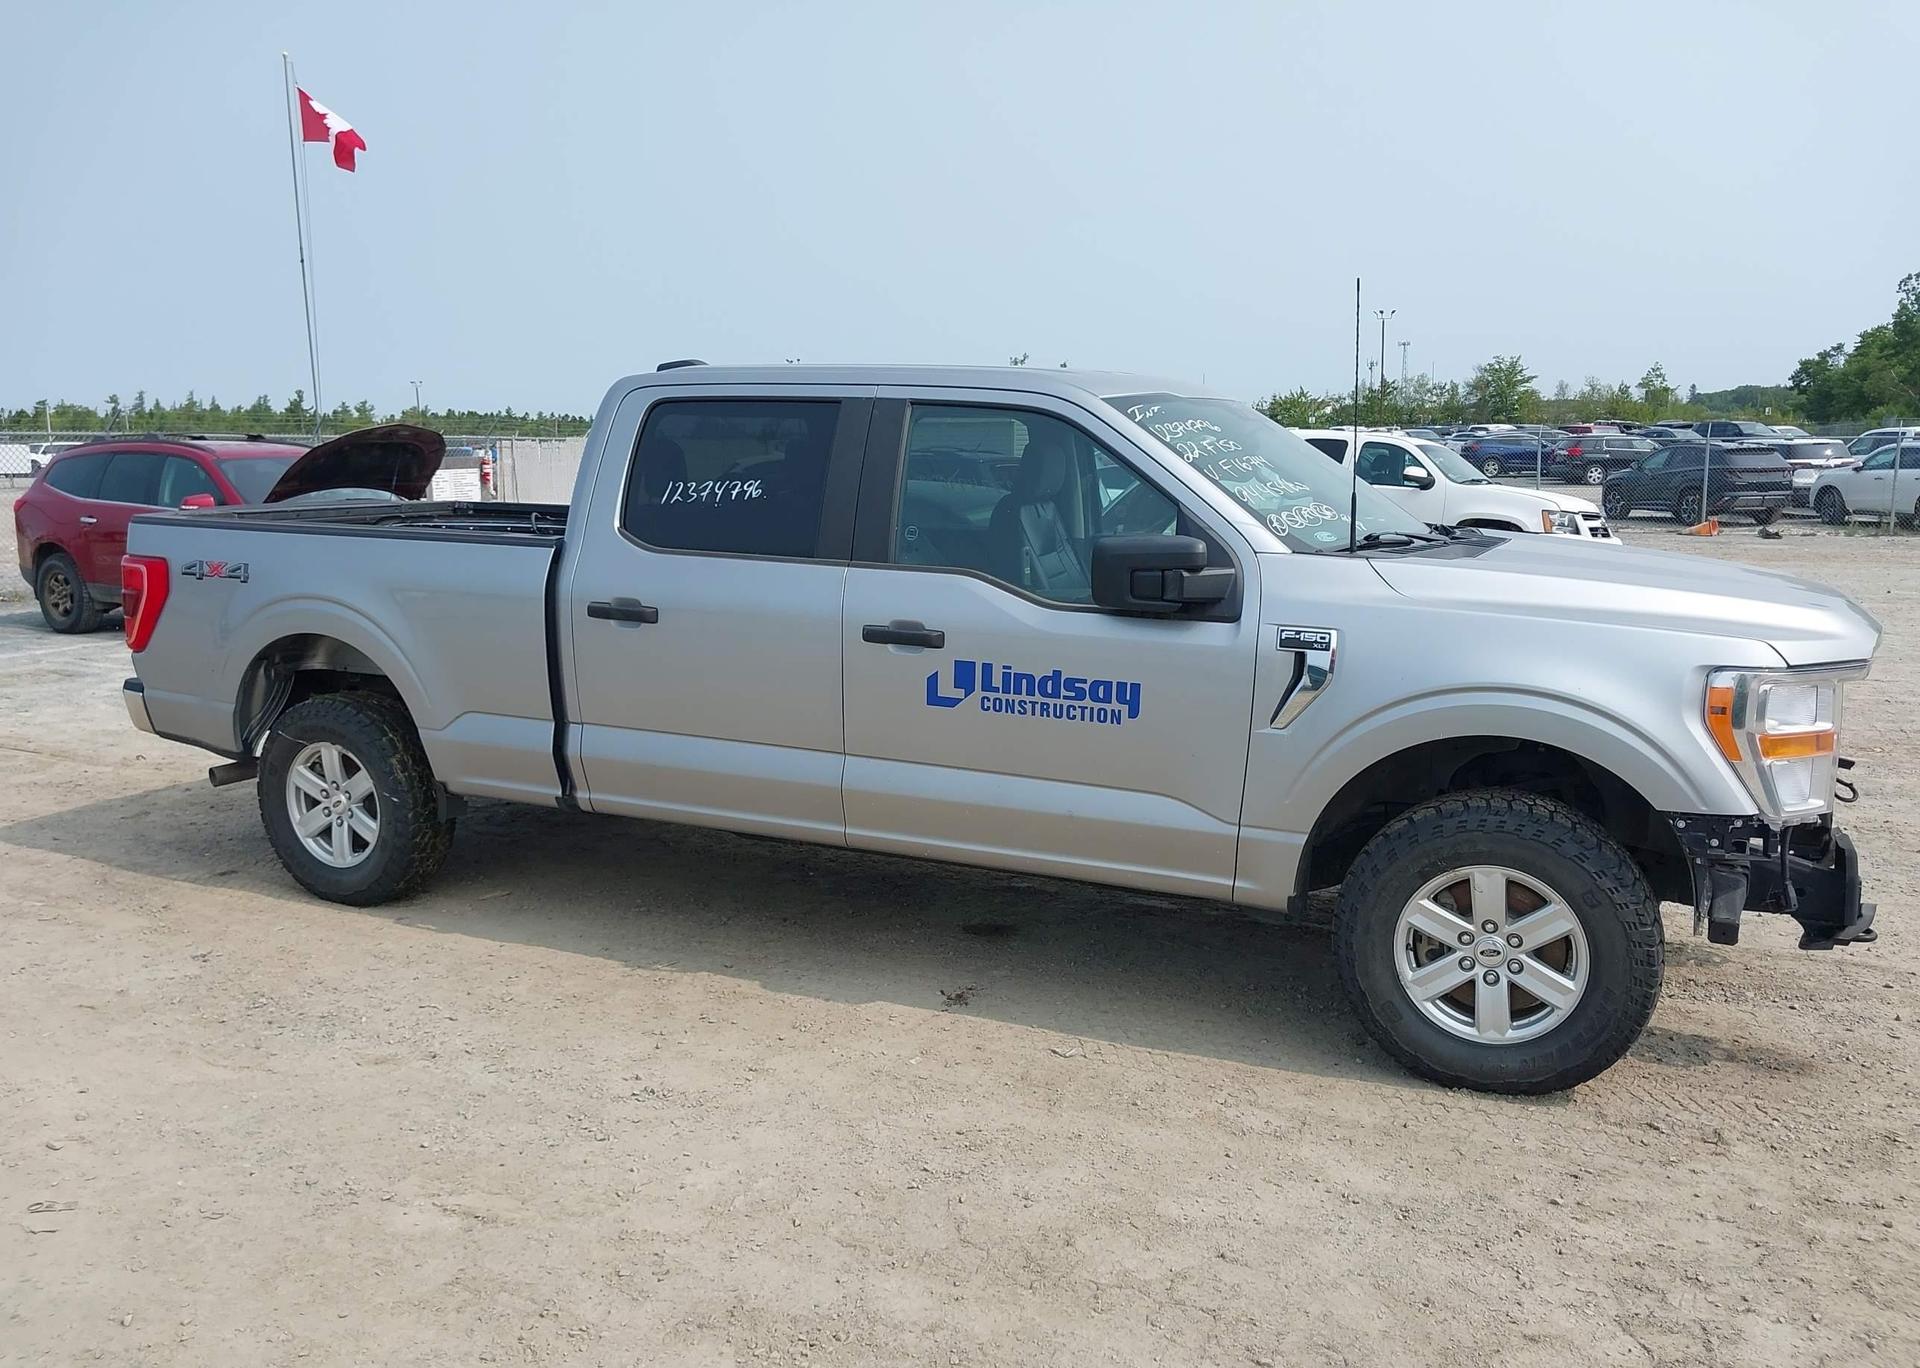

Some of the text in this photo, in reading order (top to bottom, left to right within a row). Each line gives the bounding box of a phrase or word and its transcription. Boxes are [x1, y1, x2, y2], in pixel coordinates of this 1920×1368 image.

[1281, 631, 1330, 643] F-150
[981, 662, 1142, 719] Lindsay
[980, 696, 1122, 725] CONSTRUCTION
